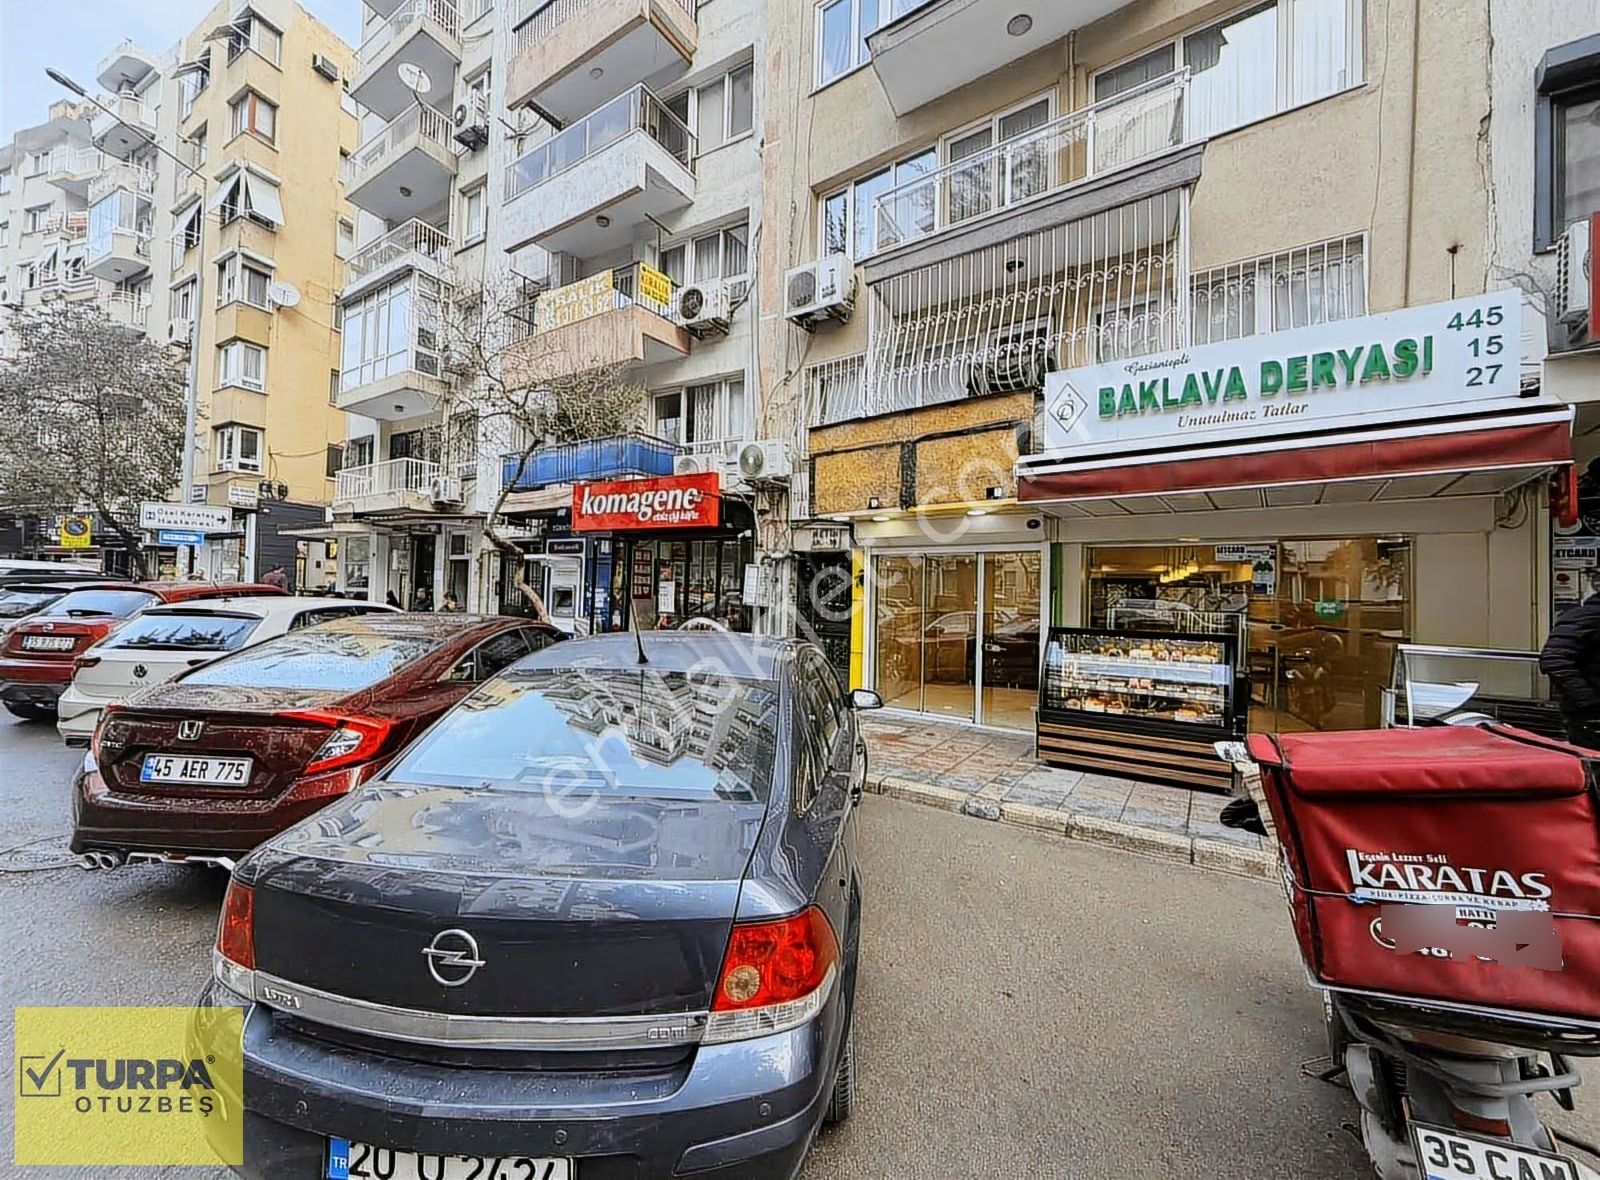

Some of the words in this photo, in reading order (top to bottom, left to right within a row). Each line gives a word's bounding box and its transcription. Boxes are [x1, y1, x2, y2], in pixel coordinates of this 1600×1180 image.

[1447, 305, 1504, 331] 445
[1467, 335, 1504, 358] 15
[1098, 366, 1248, 419] BAKLAVA
[1260, 335, 1433, 397] DERYASI
[1465, 364, 1503, 387] 27
[1178, 409, 1256, 428] Unutulmaz
[1262, 402, 1309, 418] Tatlar
[581, 487, 698, 521] komagene
[154, 759, 174, 777] 45
[180, 760, 208, 779] AER
[215, 762, 245, 781] 775
[332, 1156, 347, 1169] TR
[349, 1142, 397, 1180] 20
[1424, 1135, 1476, 1175] 35
